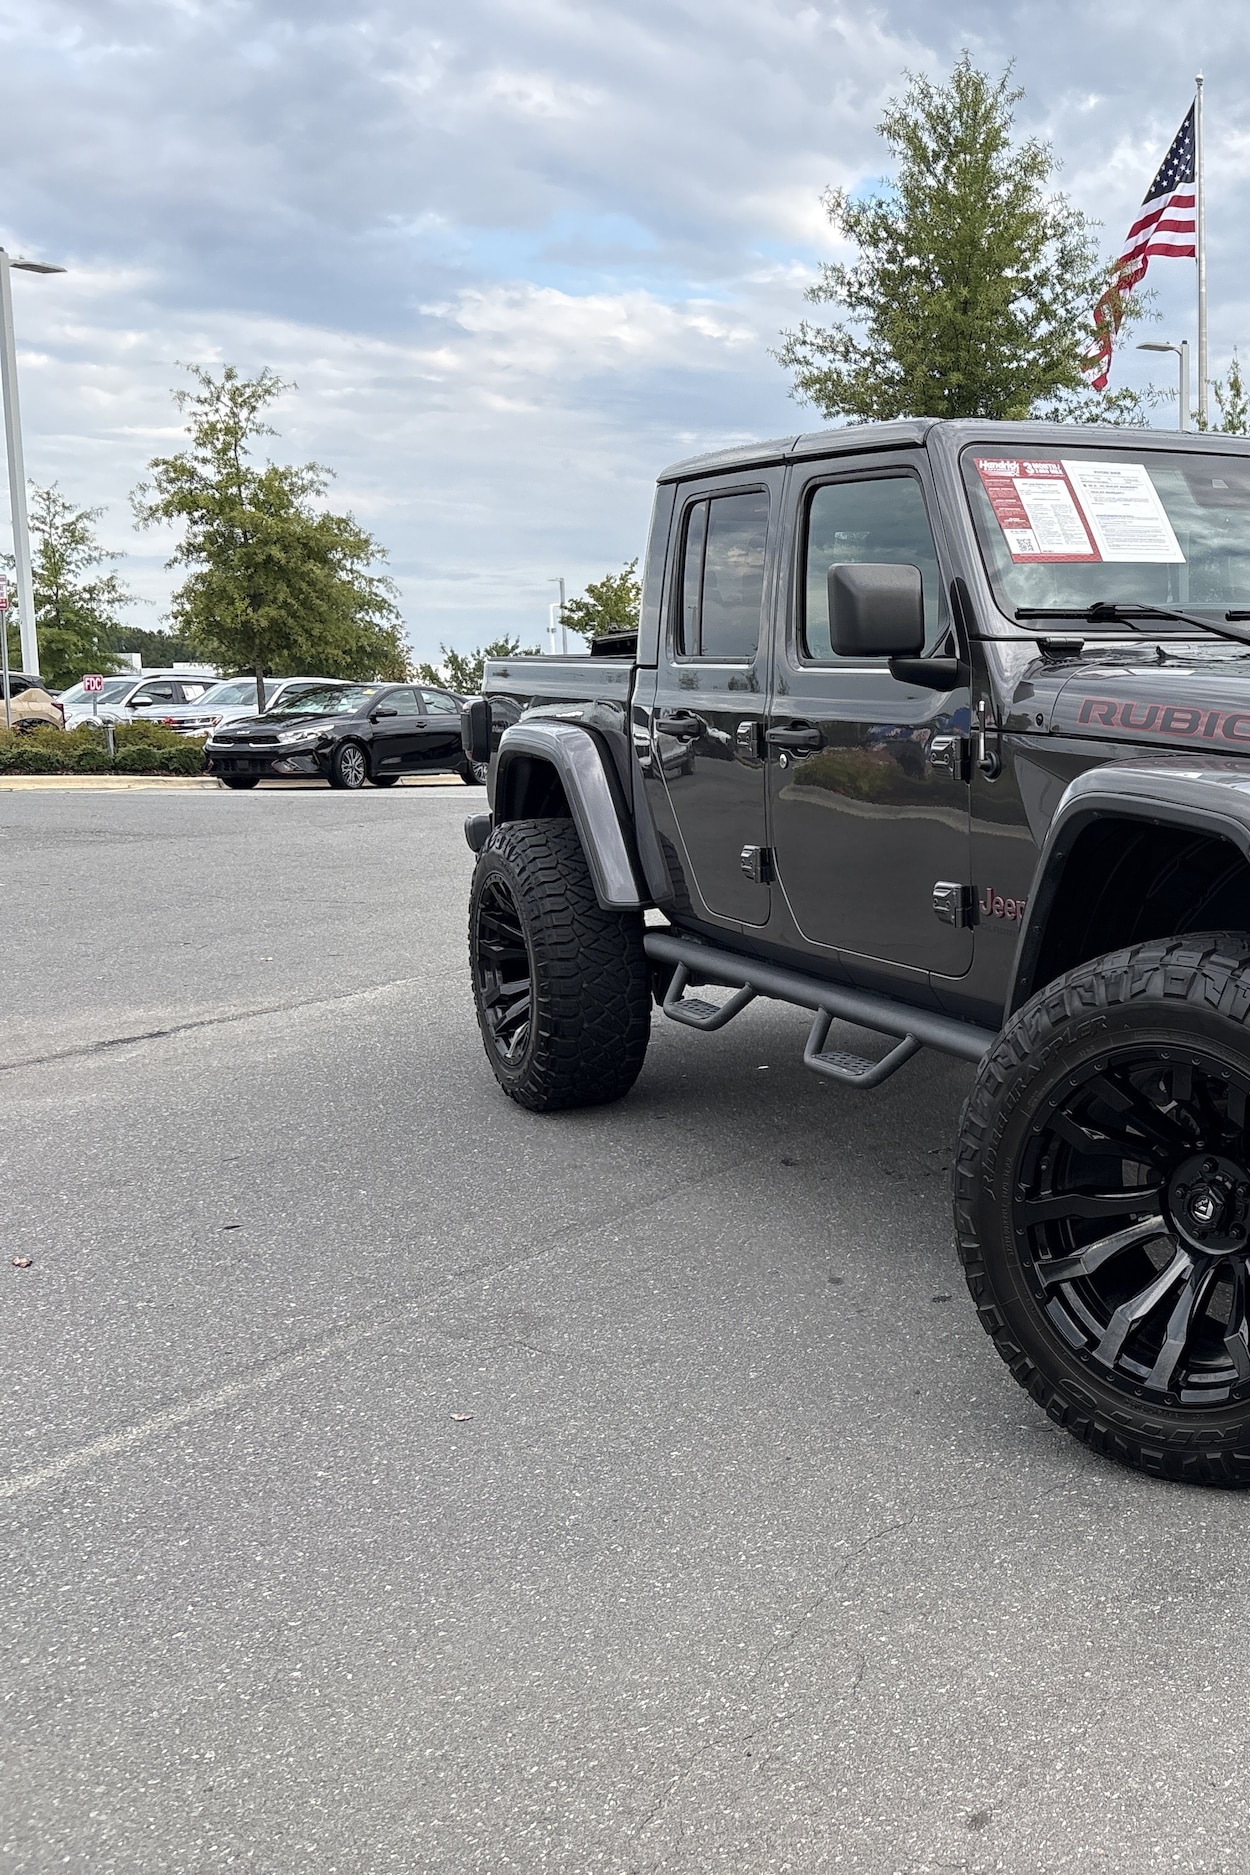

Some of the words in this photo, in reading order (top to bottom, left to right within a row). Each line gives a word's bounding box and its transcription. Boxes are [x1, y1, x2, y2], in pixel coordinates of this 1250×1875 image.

[979, 460, 1020, 473] Hendrick
[1022, 462, 1035, 475] 3
[85, 677, 102, 690] FDC
